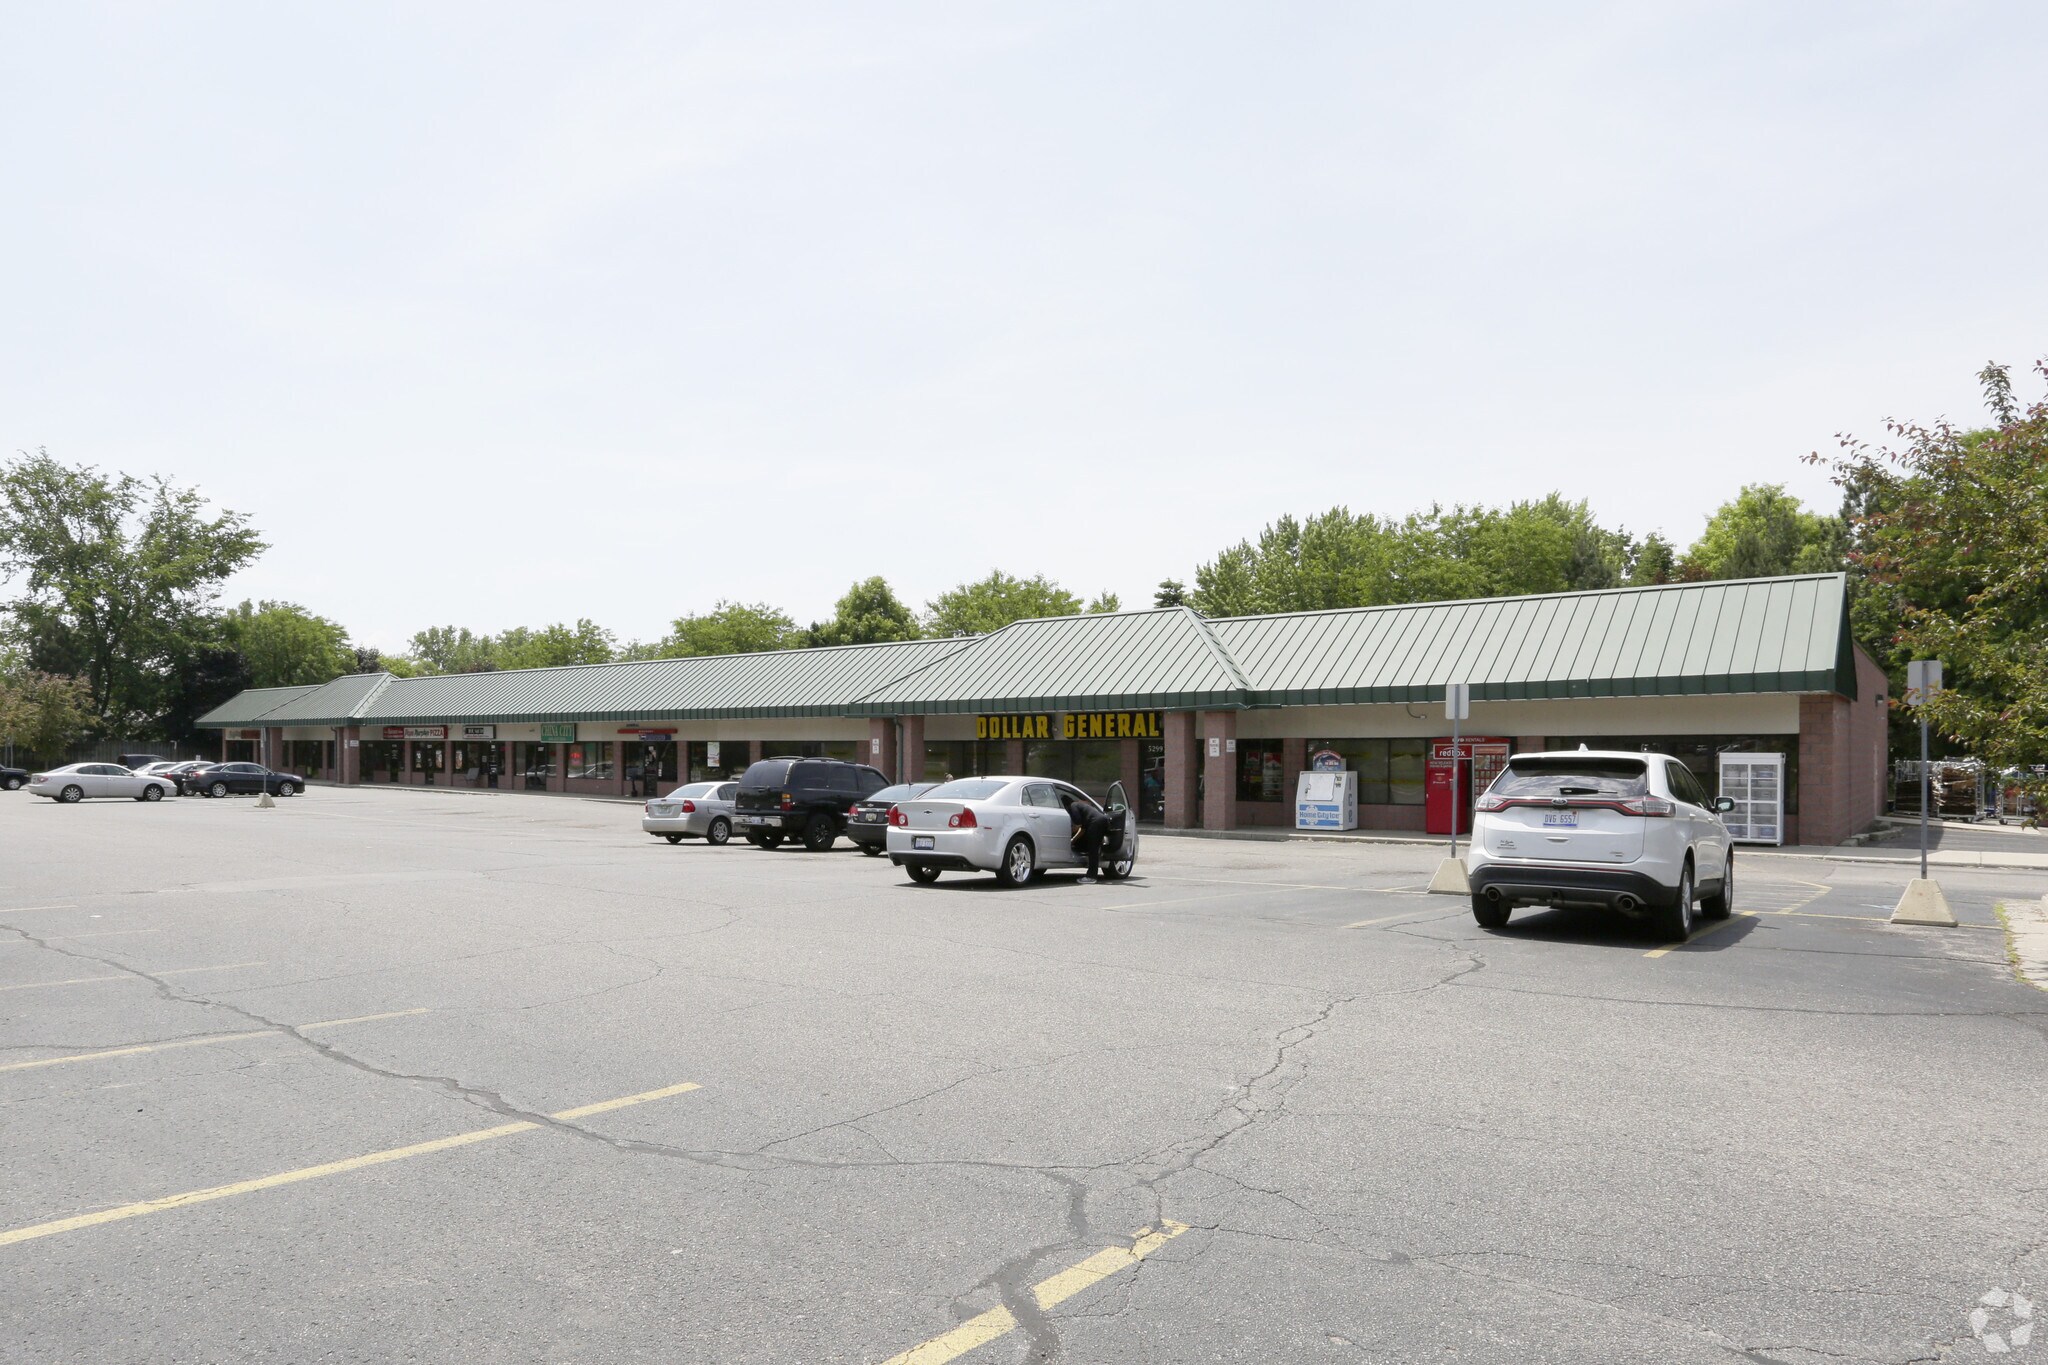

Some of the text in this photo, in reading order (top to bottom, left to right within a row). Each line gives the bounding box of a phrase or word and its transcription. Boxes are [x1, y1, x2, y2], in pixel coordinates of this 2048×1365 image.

[542, 725, 572, 737] CHINA CITY
[976, 713, 1160, 739] DOLLAR GENERAL
